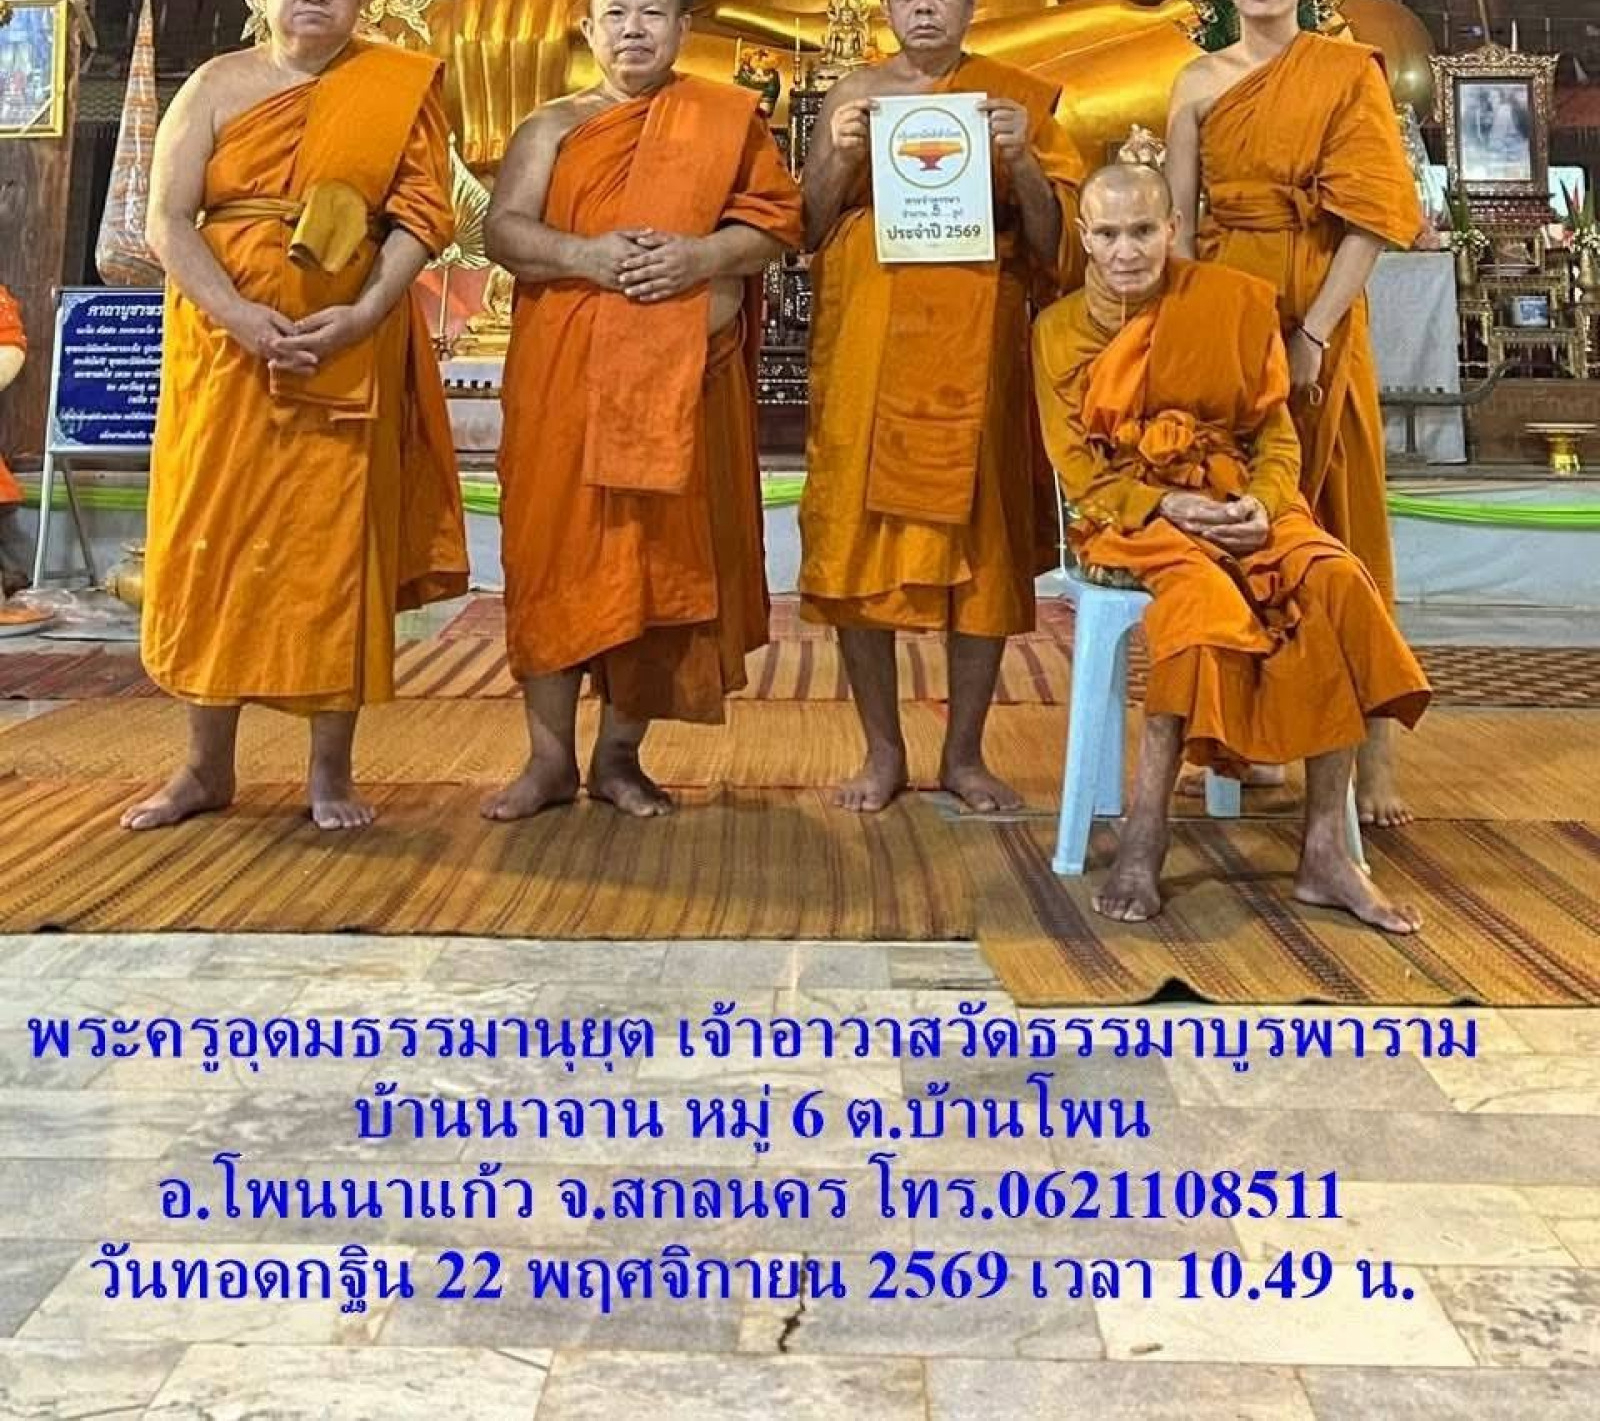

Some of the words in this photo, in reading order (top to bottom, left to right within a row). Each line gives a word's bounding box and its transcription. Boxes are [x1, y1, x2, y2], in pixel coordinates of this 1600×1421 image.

[886, 221, 941, 240] ประจำปี
[944, 223, 982, 239] 2569
